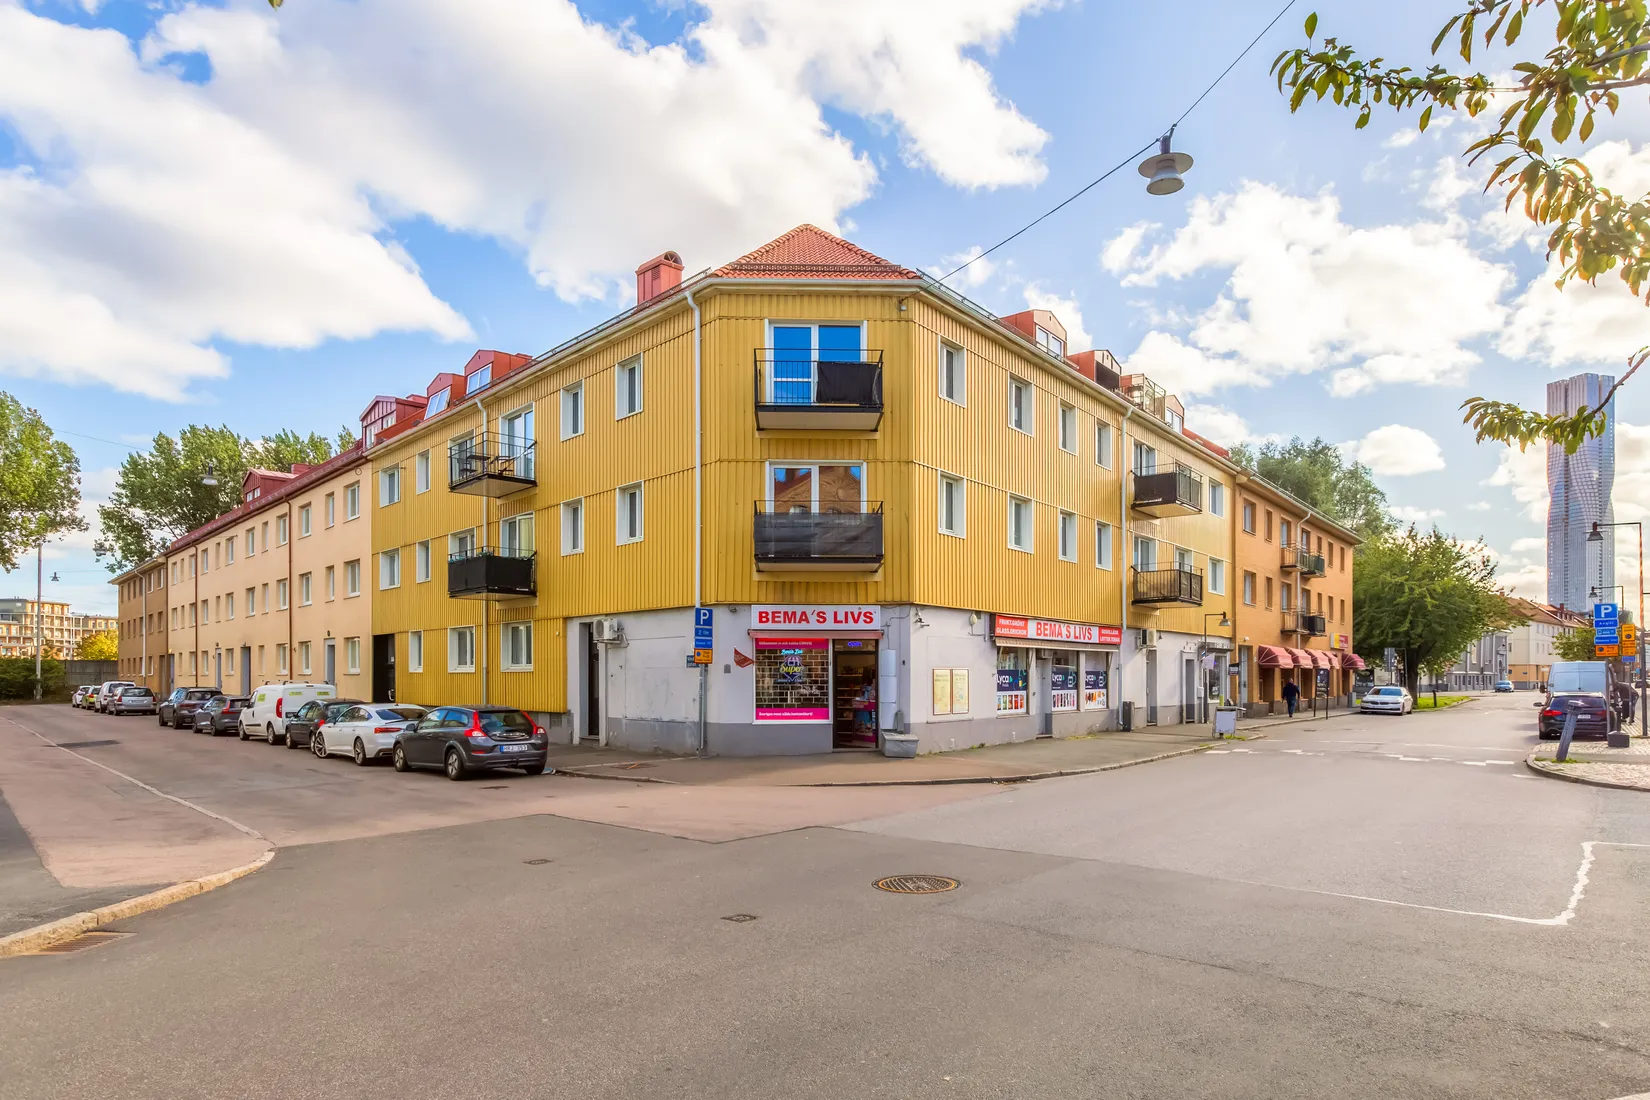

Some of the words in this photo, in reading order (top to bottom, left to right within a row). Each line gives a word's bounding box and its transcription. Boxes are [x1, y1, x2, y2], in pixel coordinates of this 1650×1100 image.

[700, 609, 709, 625] P
[833, 611, 874, 624] LIVS
[1601, 605, 1612, 617] P
[1073, 626, 1092, 640] LIVS
